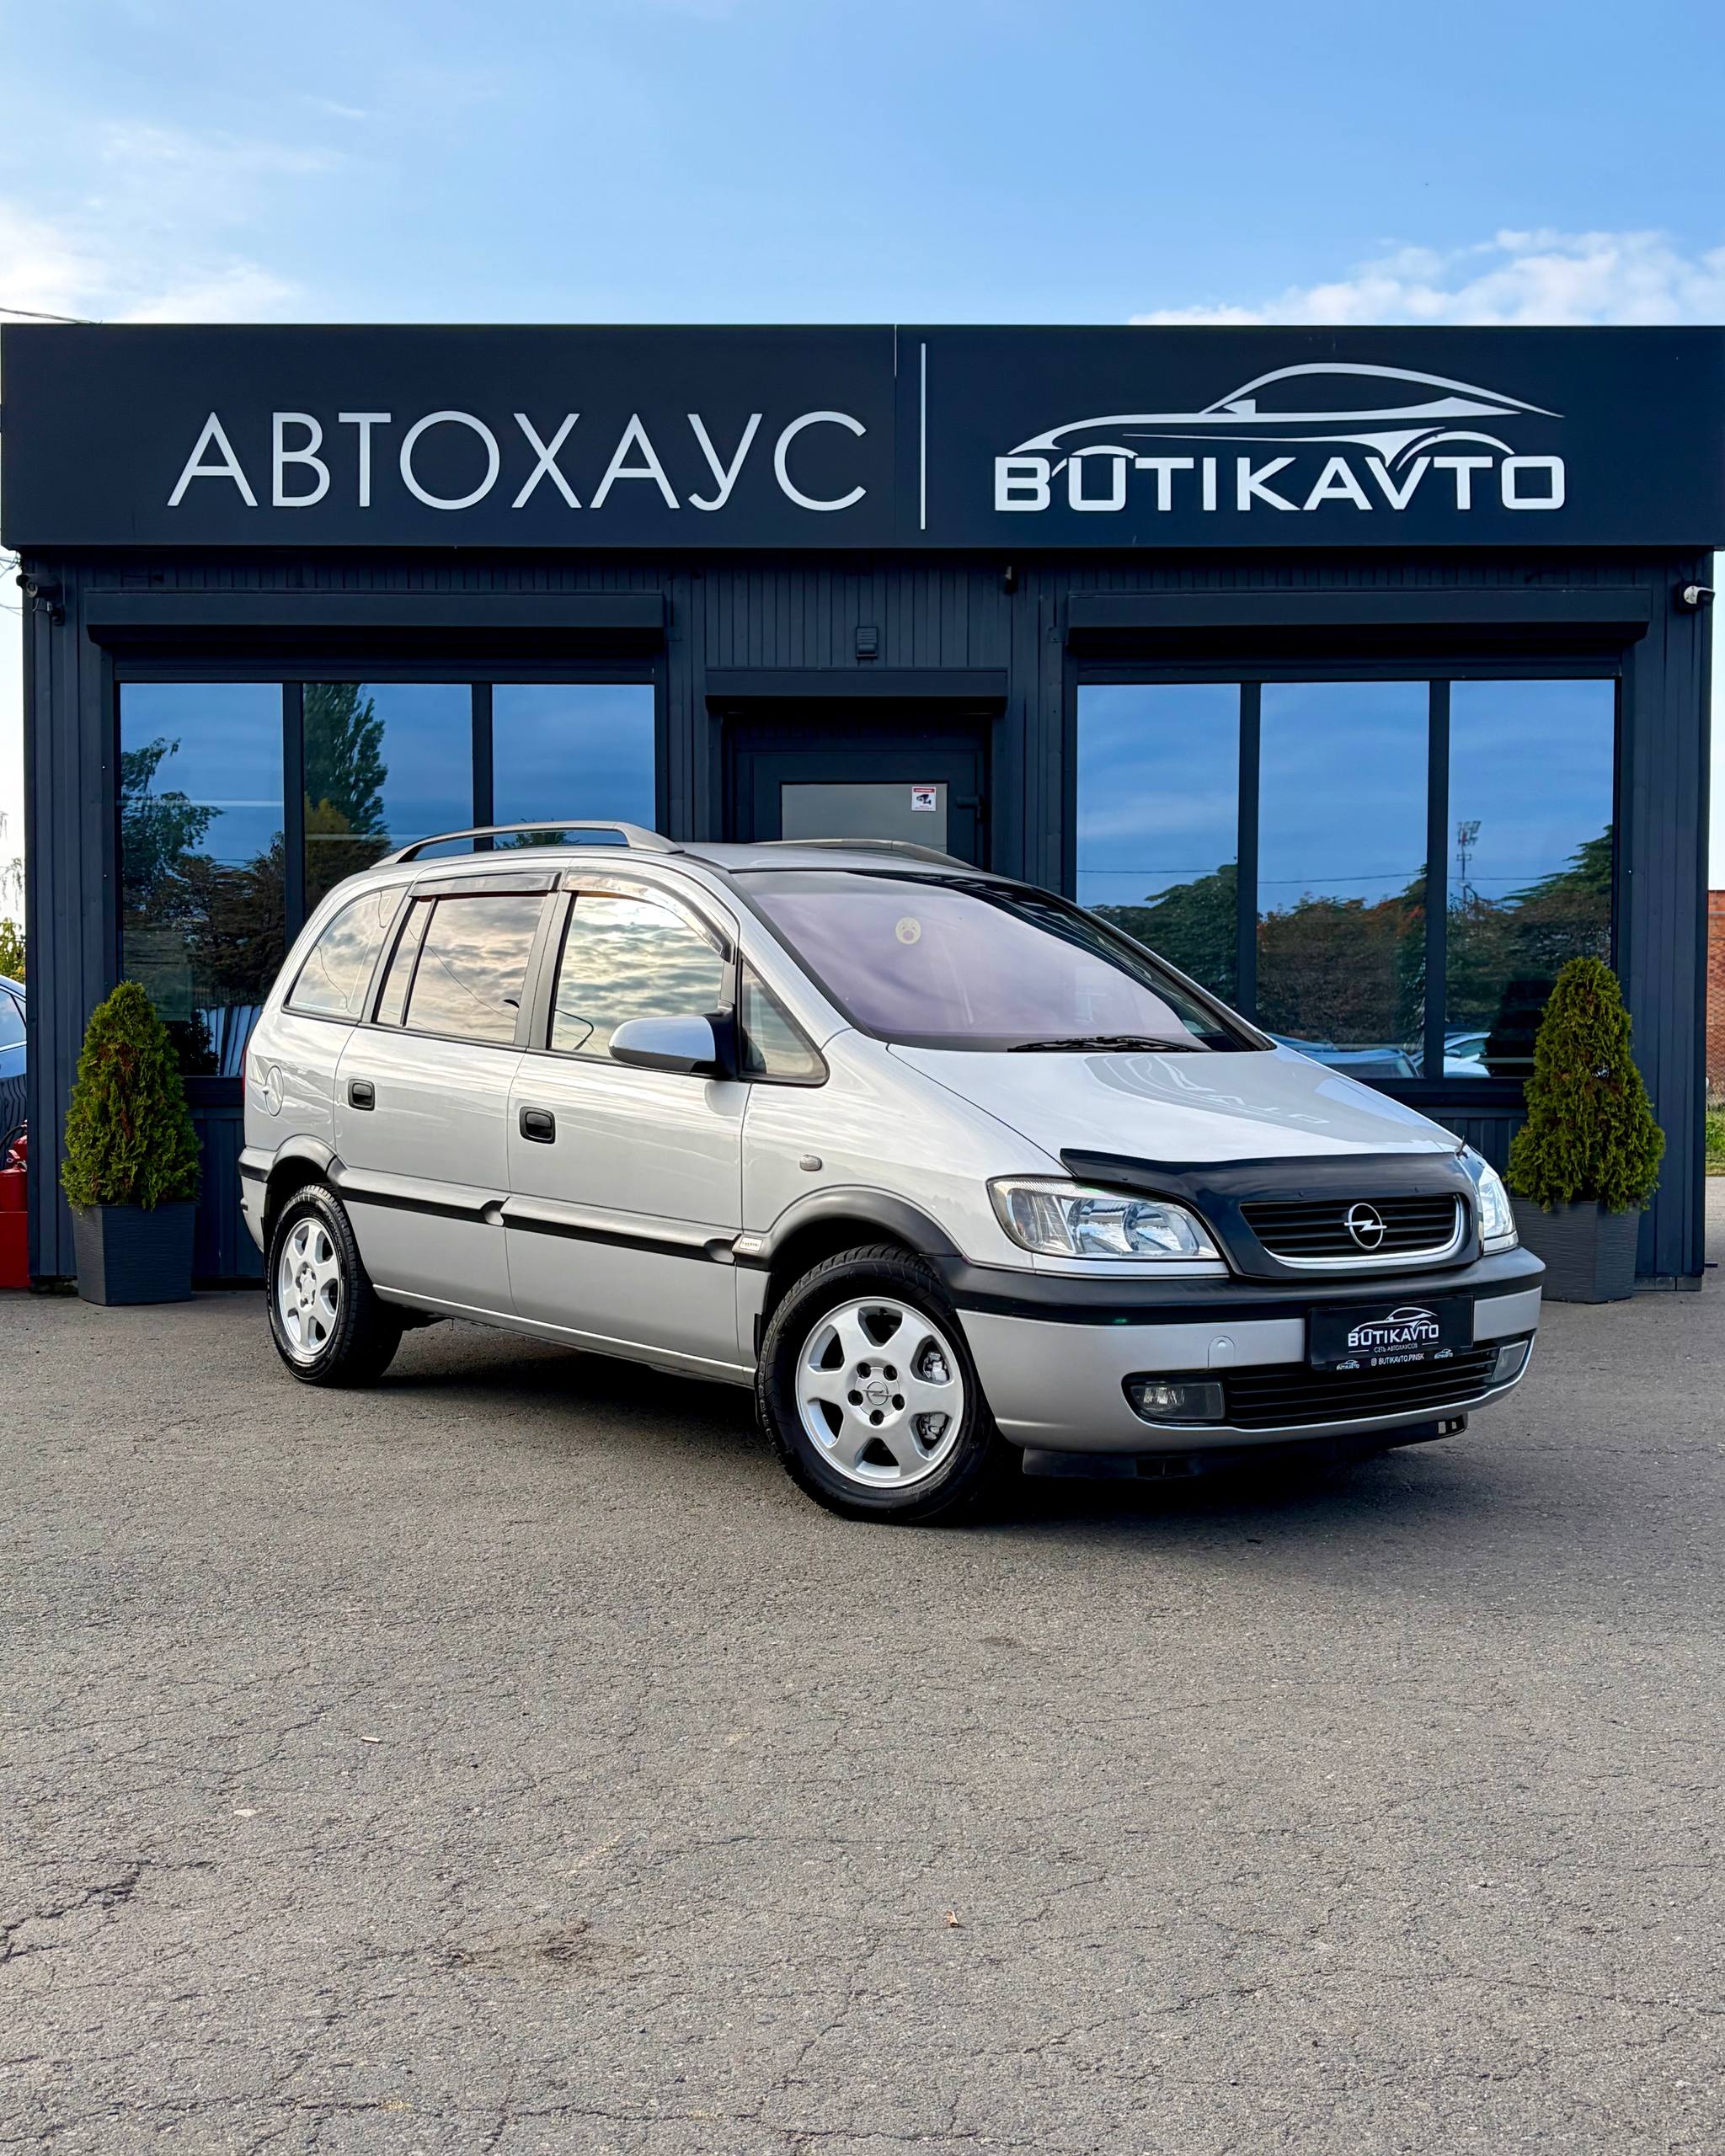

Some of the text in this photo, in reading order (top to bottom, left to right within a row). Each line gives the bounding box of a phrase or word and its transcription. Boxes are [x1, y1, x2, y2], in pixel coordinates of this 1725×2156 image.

[168, 411, 867, 511] АВТОХАУС
[995, 456, 1565, 511] BUTIKAVTO
[1348, 1324, 1439, 1347] BUTIKAVTO
